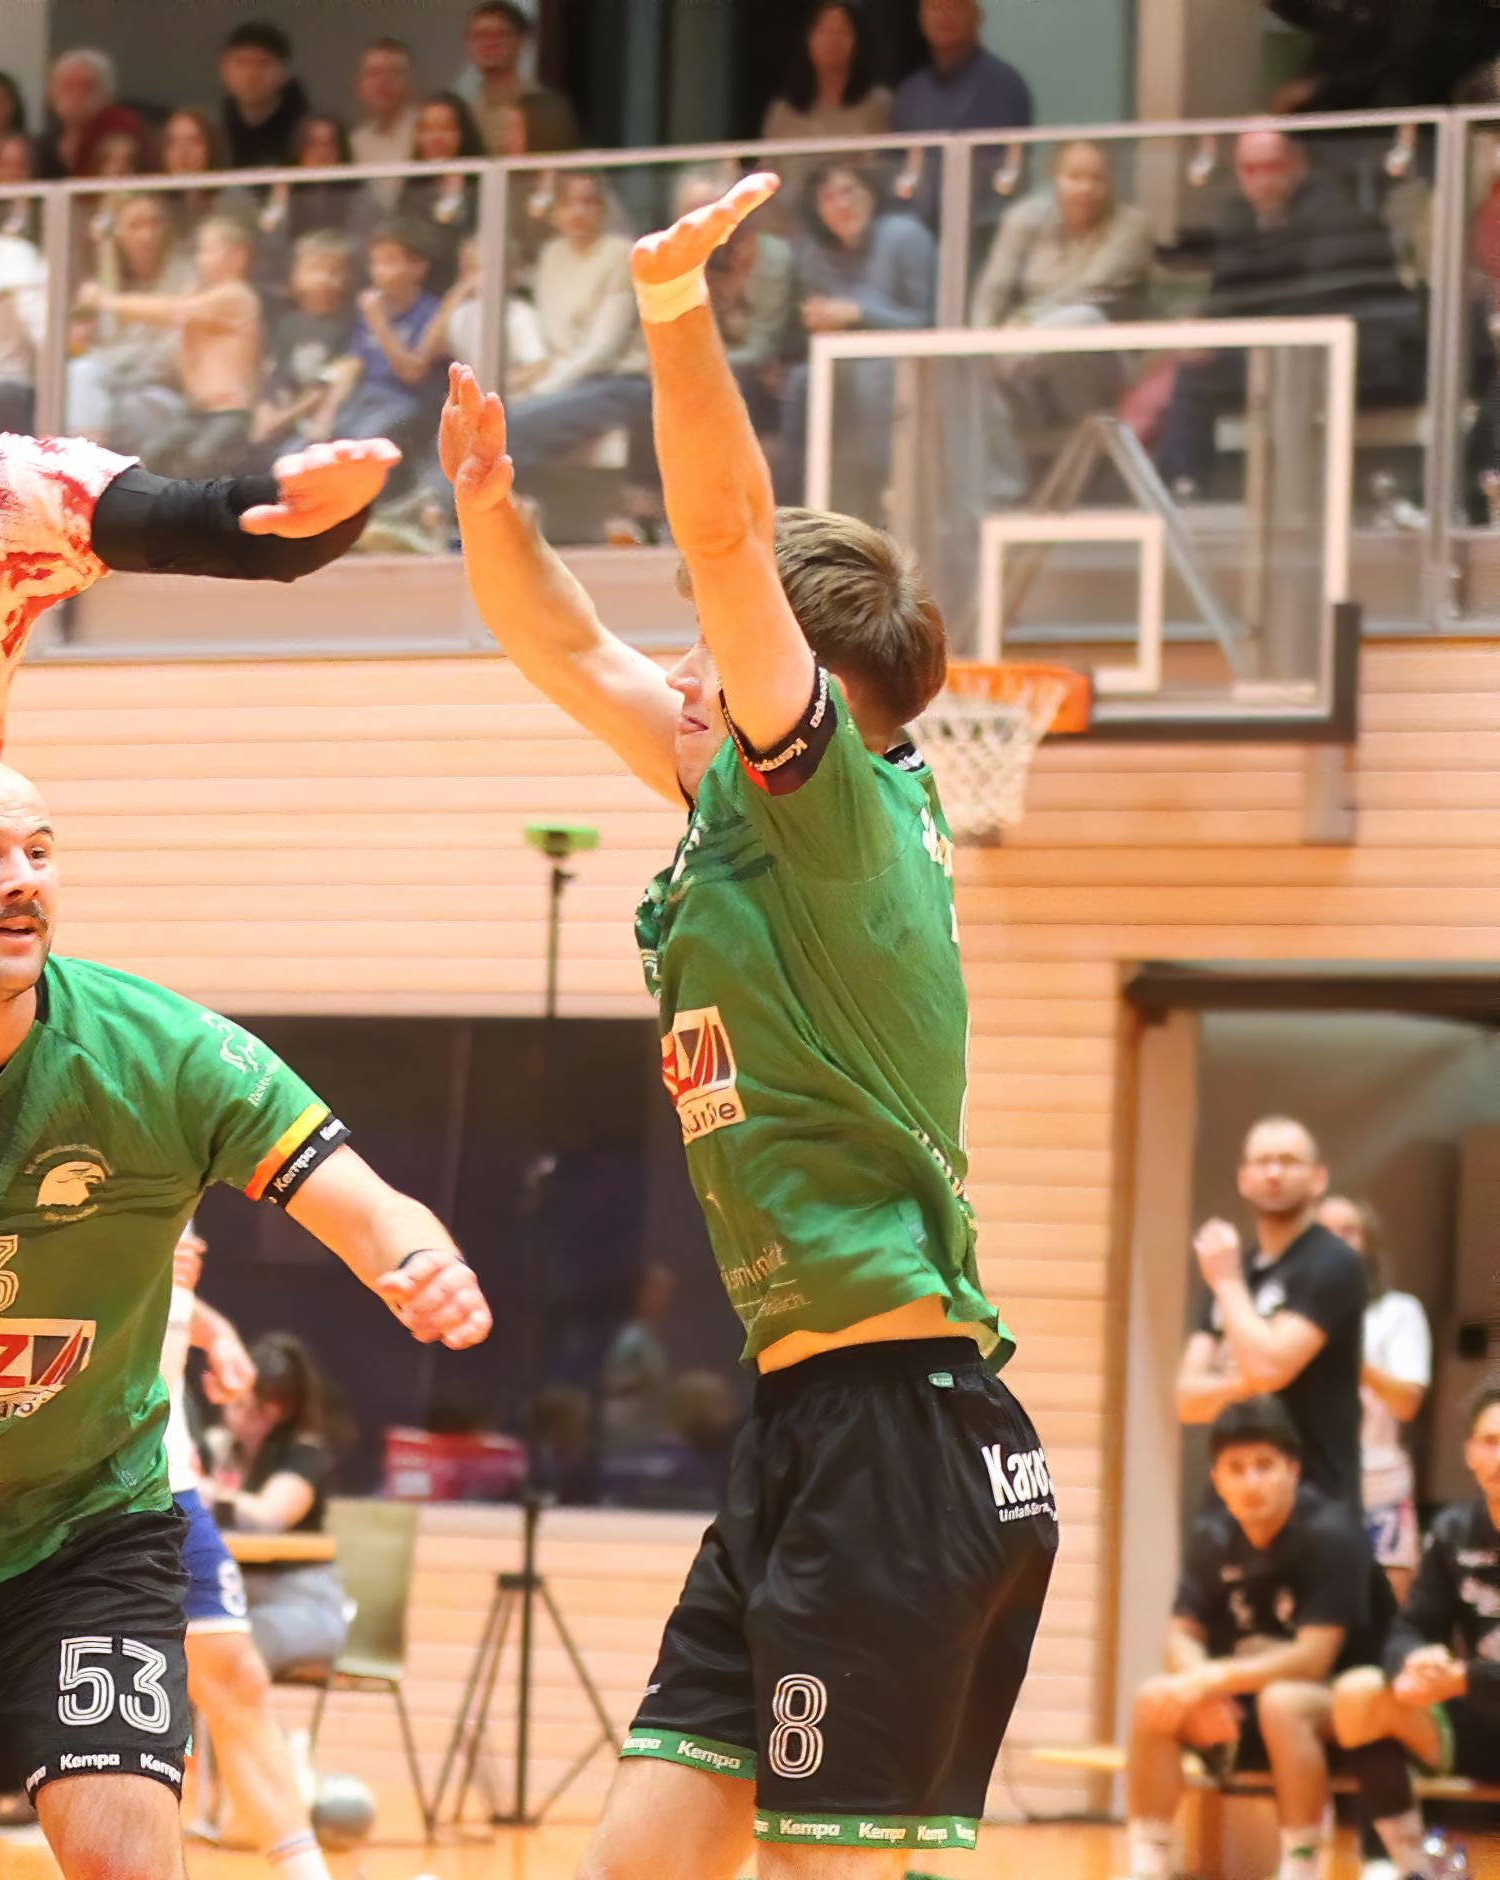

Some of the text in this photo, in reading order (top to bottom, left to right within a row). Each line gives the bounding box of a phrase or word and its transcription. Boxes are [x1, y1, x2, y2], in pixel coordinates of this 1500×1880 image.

[273, 1146, 318, 1192] Kempa
[58, 1636, 171, 1735] 53
[768, 1673, 828, 1779] 8
[60, 1753, 120, 1771] Kempa
[676, 1740, 741, 1770] Kempa
[779, 1818, 841, 1839] Kempa
